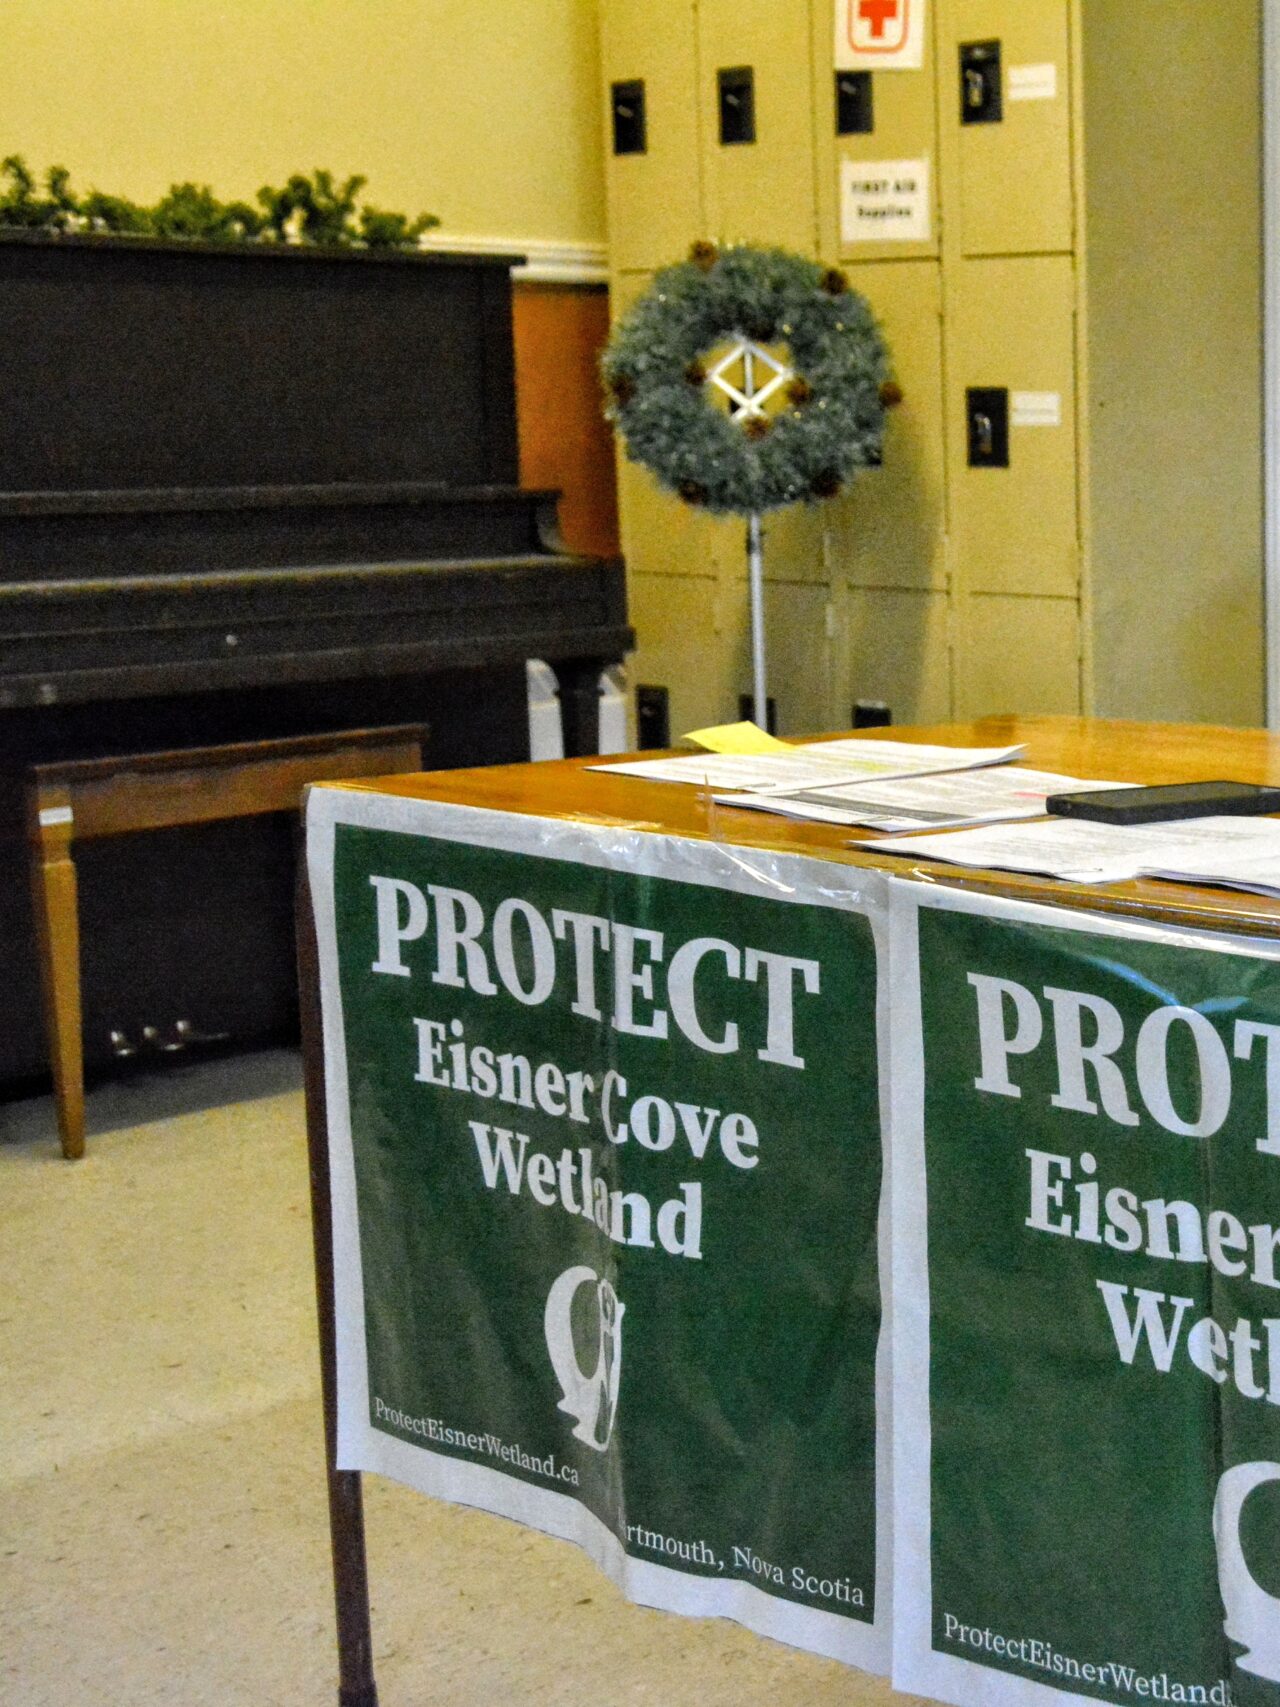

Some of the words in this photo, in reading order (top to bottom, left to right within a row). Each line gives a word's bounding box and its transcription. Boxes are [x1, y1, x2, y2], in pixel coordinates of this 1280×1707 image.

[369, 874, 821, 1070] PROTECT
[412, 1017, 595, 1123] Eisner
[600, 1069, 760, 1169] Cove
[467, 1120, 703, 1260] Wetland
[374, 1396, 580, 1487] ProtectEisnerWetland.ca
[620, 1520, 725, 1571] rtmouth,
[731, 1546, 785, 1586] Nova
[791, 1566, 865, 1607] Scotia
